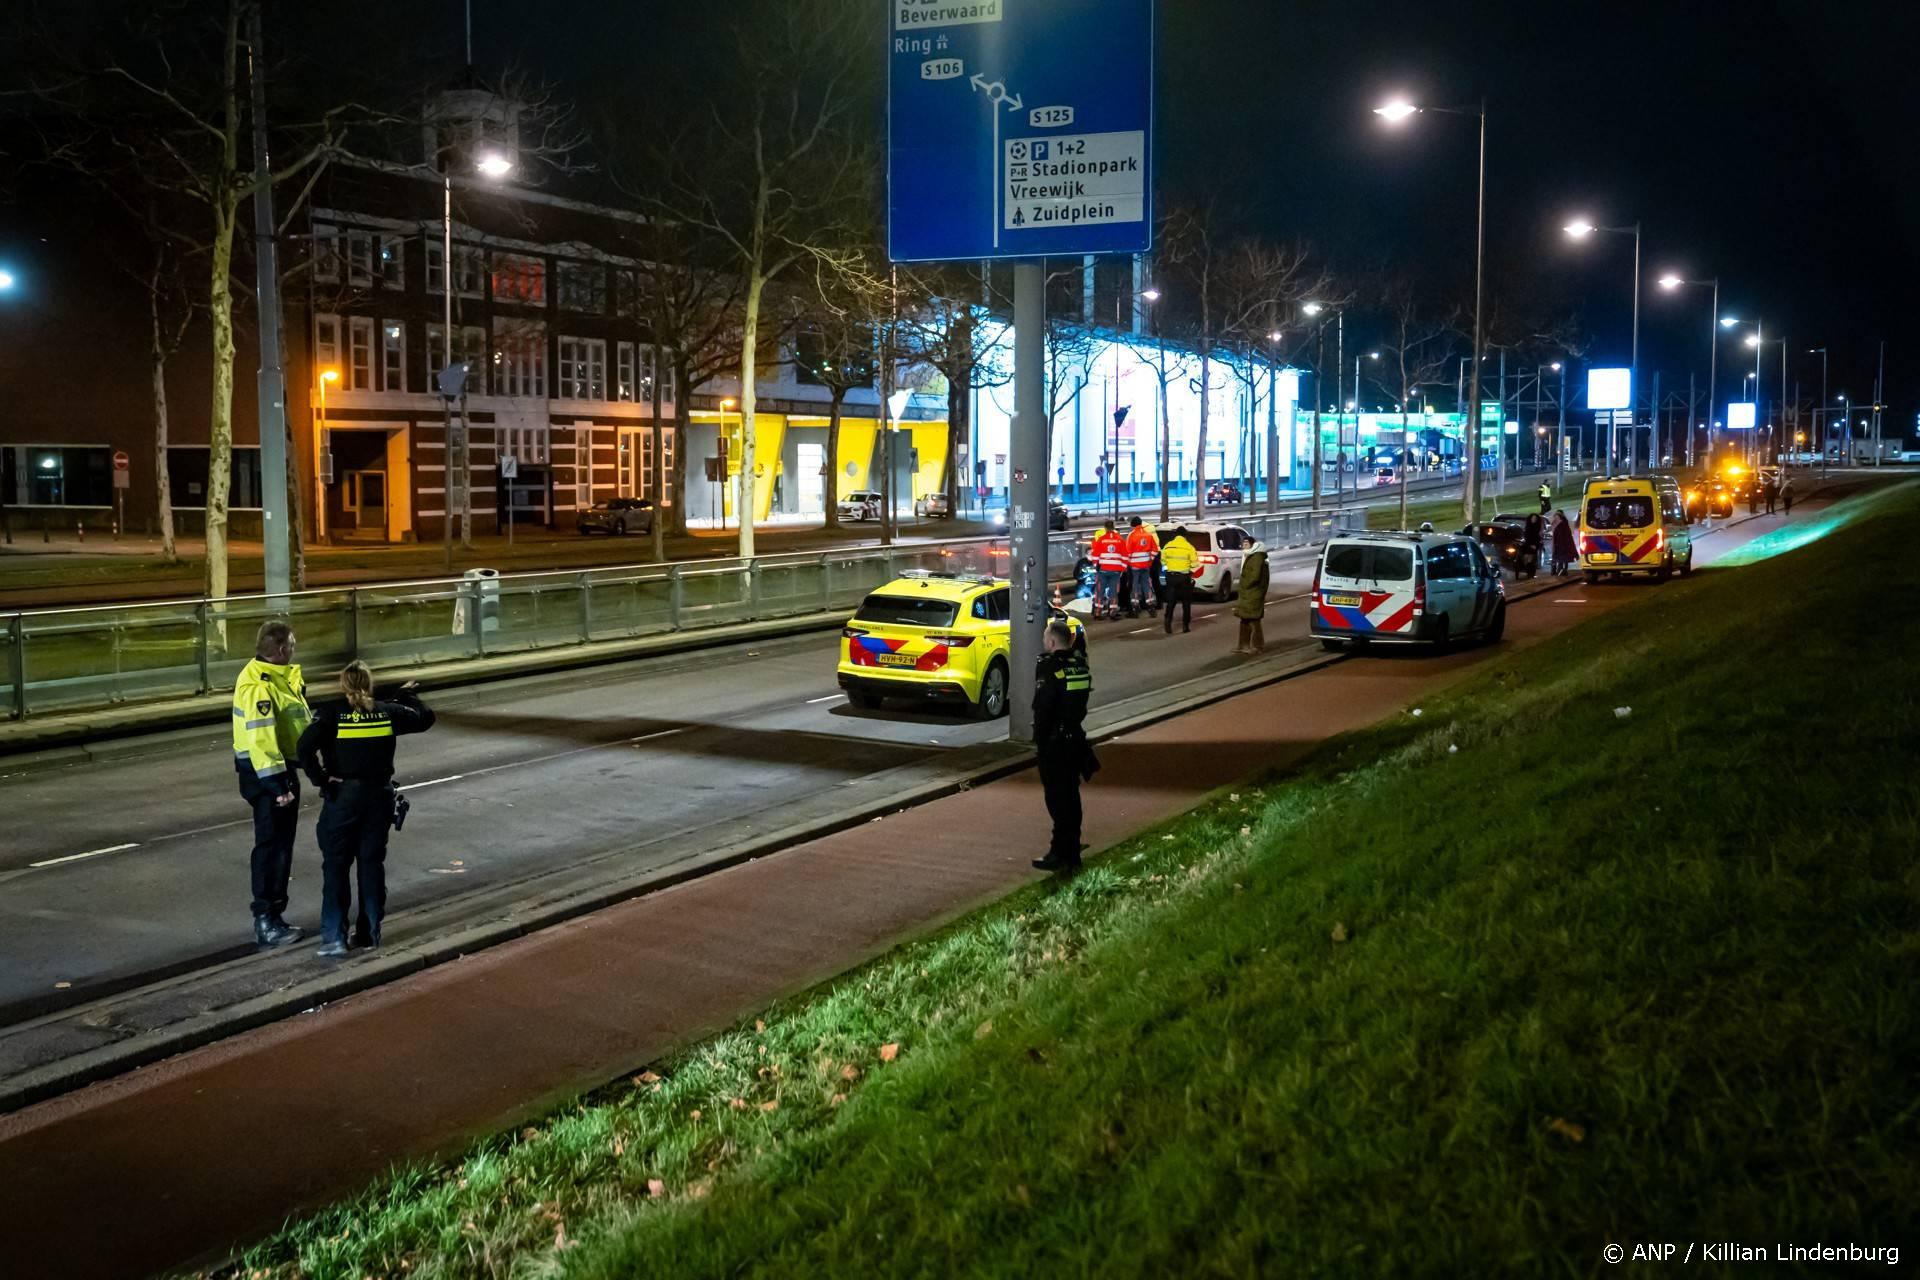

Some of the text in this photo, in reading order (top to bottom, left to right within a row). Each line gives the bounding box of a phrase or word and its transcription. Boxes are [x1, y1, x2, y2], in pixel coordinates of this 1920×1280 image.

[901, 1, 996, 24] Beverwaard
[895, 37, 931, 55] Ring
[925, 62, 960, 76] S 106
[1033, 109, 1070, 123] S 125
[1057, 140, 1085, 155] 1+2
[1032, 157, 1137, 177] Stadionpark
[1011, 181, 1084, 199] Vreewijk
[1033, 203, 1114, 223] Zuidplein
